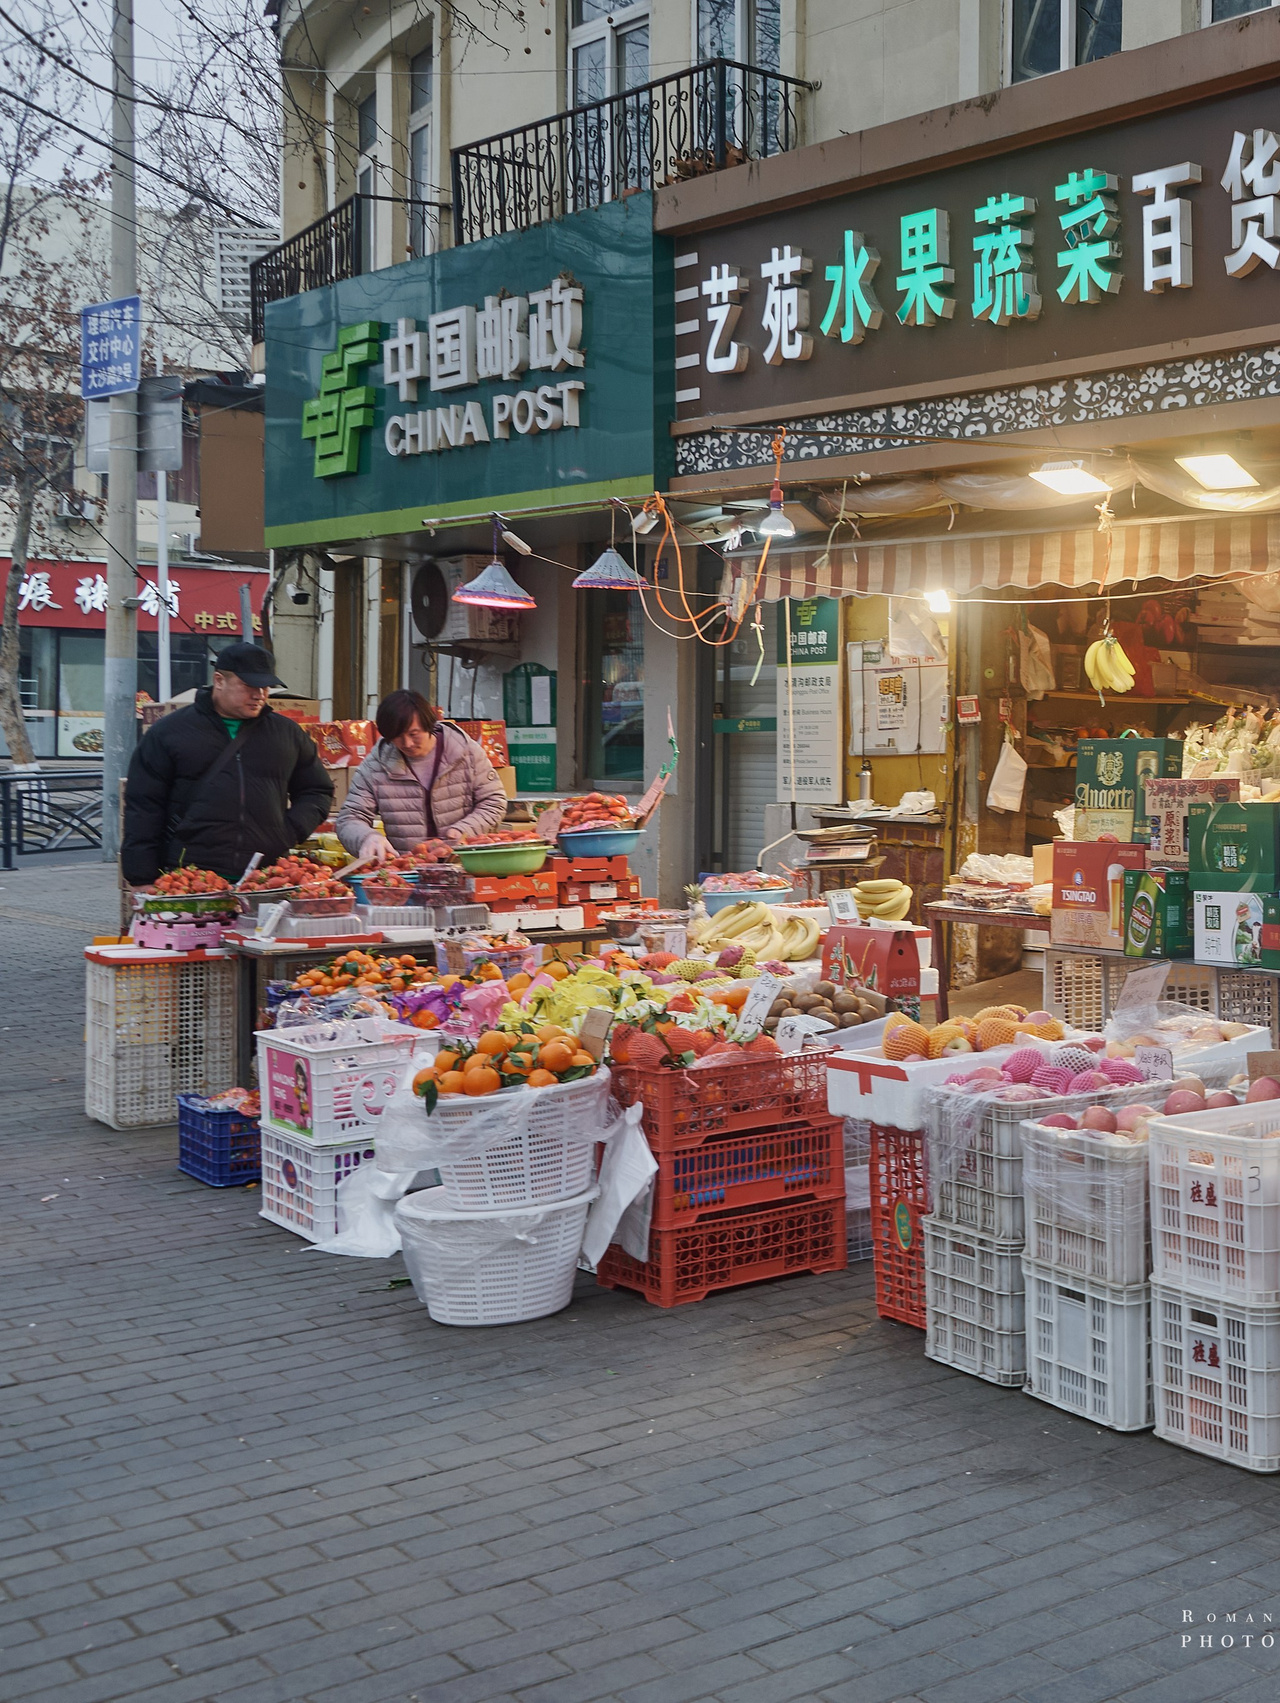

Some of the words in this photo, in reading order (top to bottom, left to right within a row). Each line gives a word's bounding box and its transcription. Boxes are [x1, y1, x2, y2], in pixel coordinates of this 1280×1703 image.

[88, 305, 134, 335] 理想汽车
[88, 334, 134, 363] 交付中心
[382, 278, 586, 402] 中国邮政
[385, 401, 490, 456] CHINA
[493, 380, 585, 439] POST
[810, 646, 828, 655] POST
[1060, 889, 1096, 903] TSINGTAO
[1247, 1165, 1261, 1194] 3
